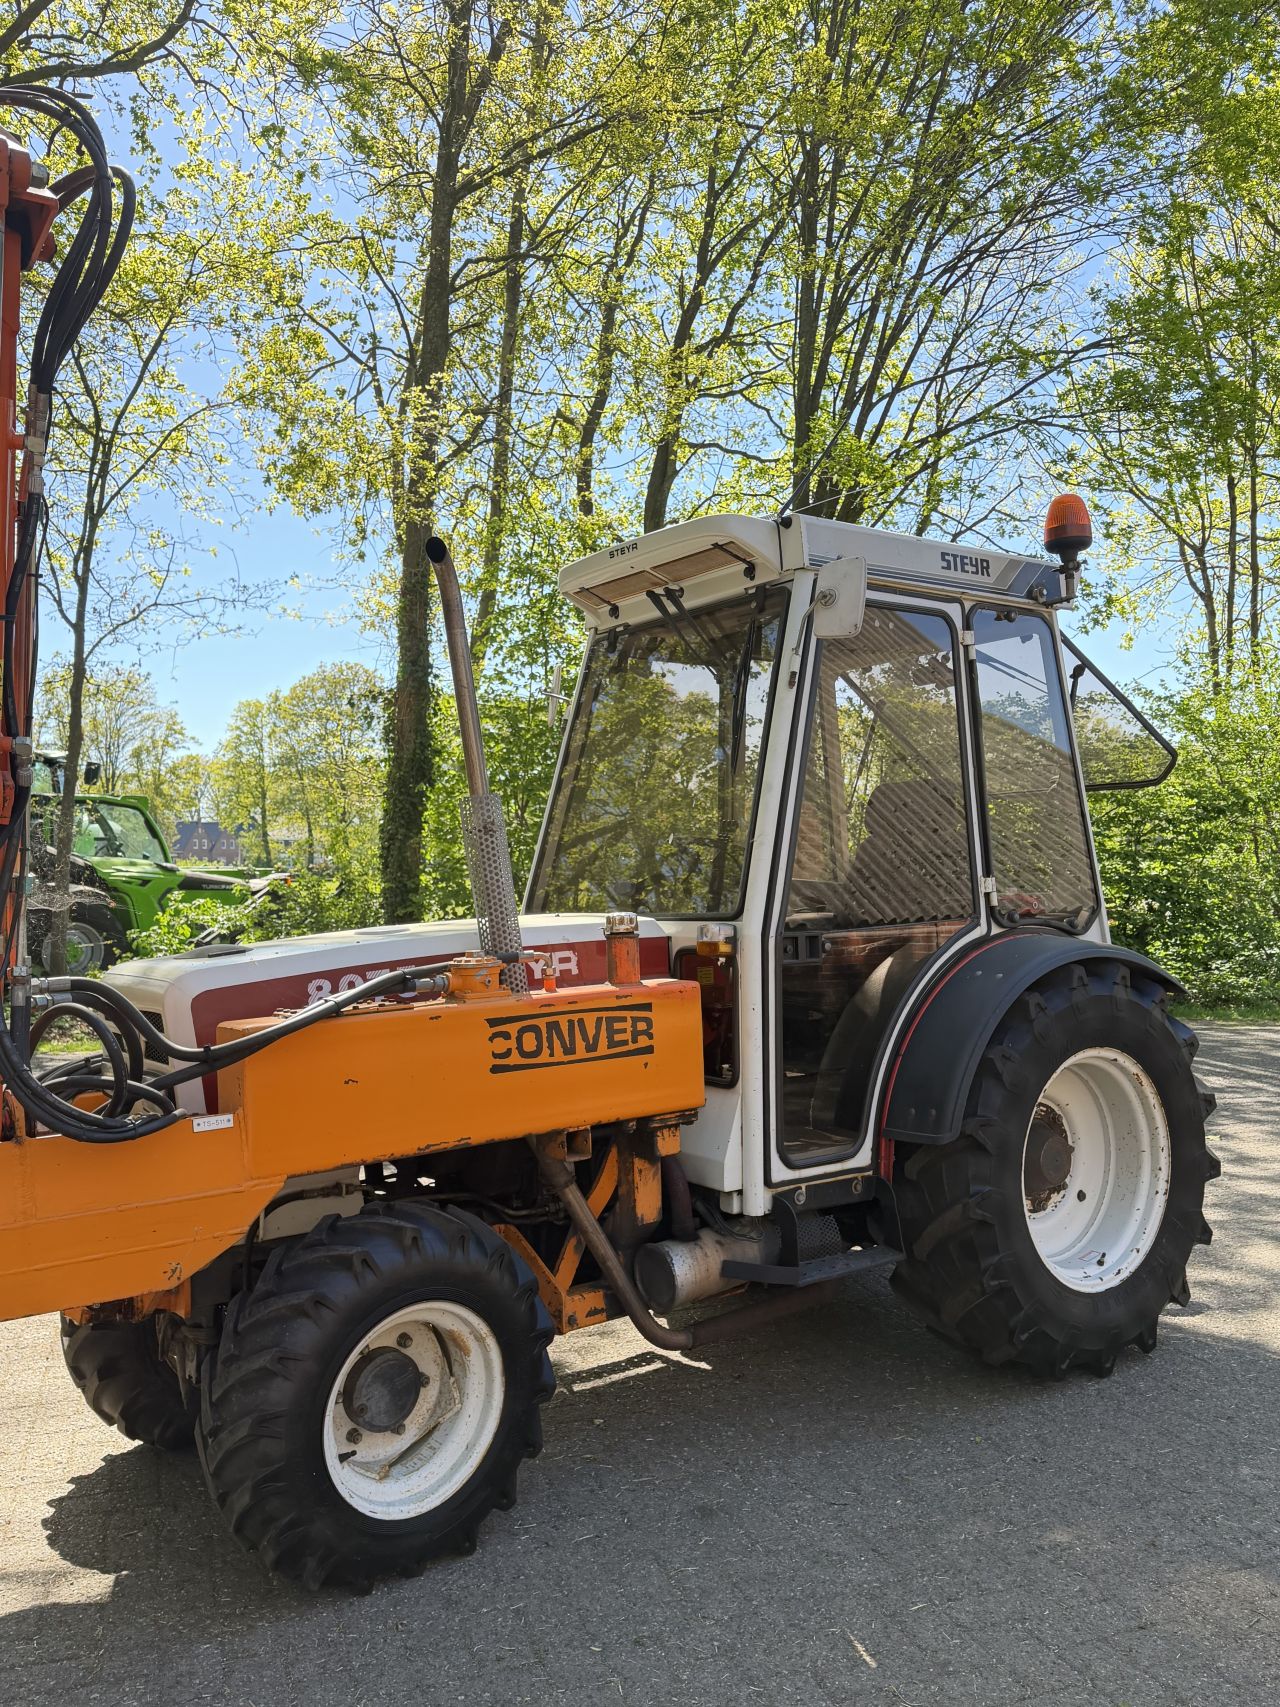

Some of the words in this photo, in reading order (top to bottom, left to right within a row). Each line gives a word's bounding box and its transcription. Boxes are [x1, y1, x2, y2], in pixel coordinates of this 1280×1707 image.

[608, 542, 638, 559] STEYR
[940, 551, 991, 578] STEYR
[488, 1016, 654, 1060] CONVER
